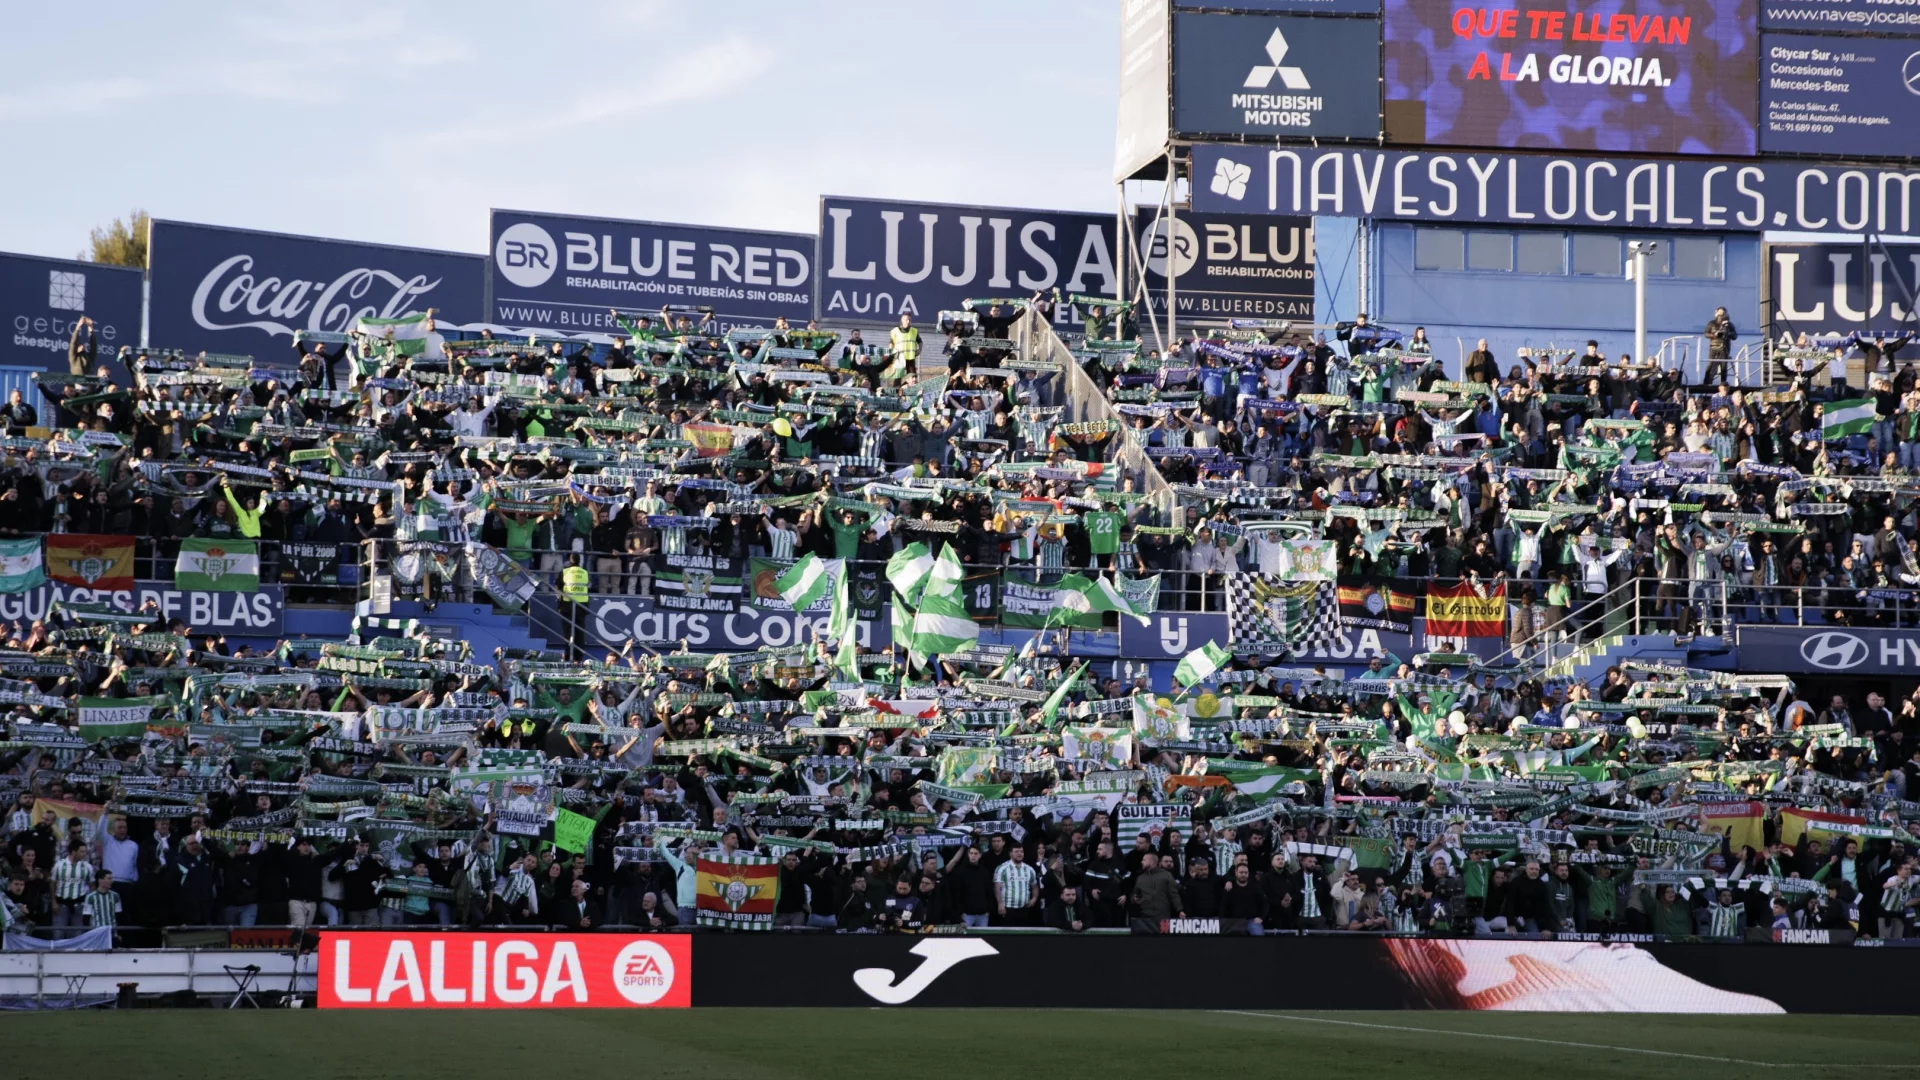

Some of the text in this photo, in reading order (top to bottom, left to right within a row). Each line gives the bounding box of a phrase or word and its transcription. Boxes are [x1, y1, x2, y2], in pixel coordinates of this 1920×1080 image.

[1452, 8, 1691, 44] QUE TE LLEVAN
[1771, 47, 1810, 61] Citycar
[1811, 49, 1831, 61] Sur
[1467, 52, 1671, 87] A LA GLORIA.
[1771, 63, 1844, 77] Concesionario
[1771, 78, 1850, 93] Mercedes-Benz
[1232, 94, 1322, 111] MITSUBISHI
[1782, 102, 1806, 111] Carlos
[1244, 111, 1311, 126] MOTORS
[1769, 112, 1796, 121] Ciudad
[1797, 113, 1808, 121] del
[1848, 115, 1857, 123] de
[828, 207, 1117, 294] LUJISA
[565, 231, 696, 279] BLUE
[709, 243, 810, 287] RED
[1207, 265, 1301, 279] REHABILITACIÓN
[566, 277, 809, 304] REHABILITACIÓN DE TUBERÍAS SIN OBRAS
[828, 289, 919, 317] AUNA
[1097, 517, 1113, 534] 22
[283, 544, 291, 556] LA
[314, 546, 336, 558] 2000
[715, 556, 731, 570] ES
[974, 583, 992, 609] 13
[190, 591, 276, 628] BLAS
[1431, 603, 1501, 616] El Garrobo
[595, 604, 710, 646] Cars
[1237, 643, 1259, 652] REAL
[9, 665, 70, 674] REAL BETIS
[909, 688, 937, 698] DONDE
[947, 700, 974, 709] DONDE
[84, 707, 147, 723] LINARES
[714, 719, 768, 733] REAL BETIS
[127, 805, 194, 816] REAL BETIS
[495, 809, 547, 826] AGUADULCE
[1121, 805, 1191, 819] GUILLENA
[497, 822, 541, 837] HERRERA
[1828, 823, 1884, 835] CANTILLANA
[1160, 918, 1220, 935] #FANCAM
[1773, 928, 1831, 945] #FANCAM
[334, 939, 663, 1003] LALIGA EA
[622, 975, 665, 987] SPORTS
